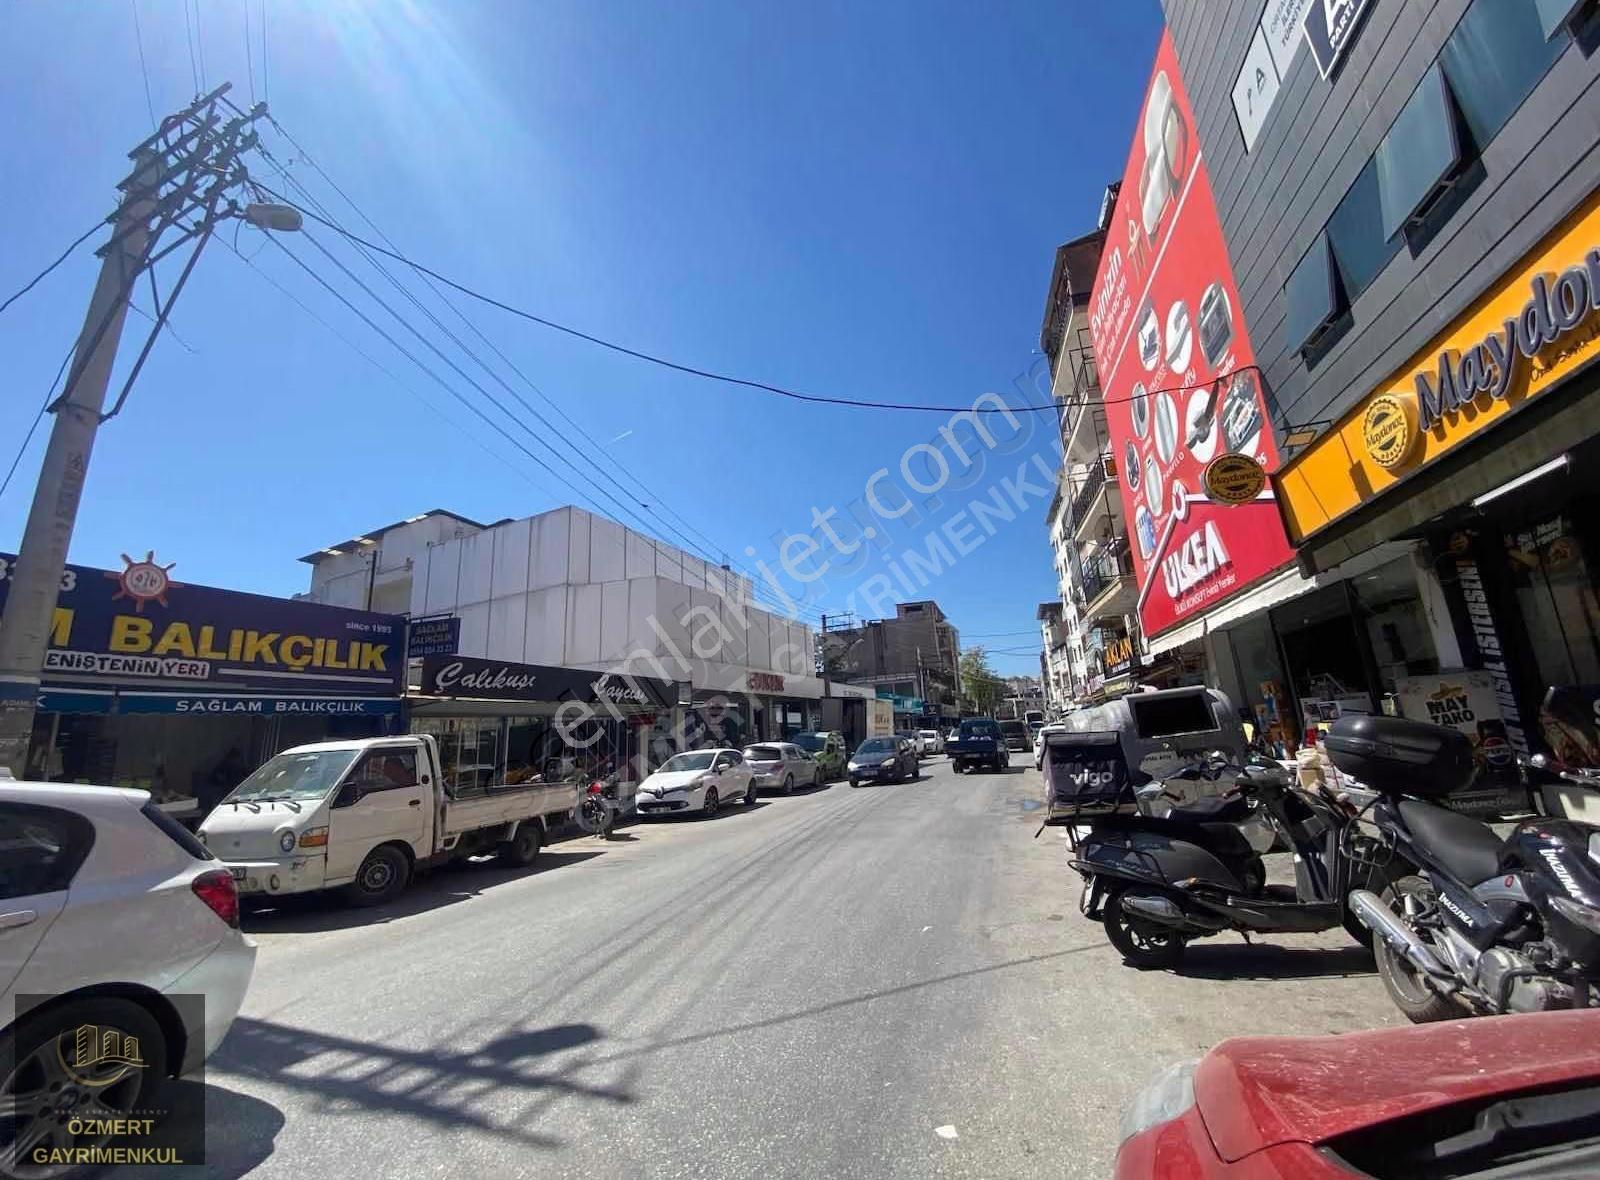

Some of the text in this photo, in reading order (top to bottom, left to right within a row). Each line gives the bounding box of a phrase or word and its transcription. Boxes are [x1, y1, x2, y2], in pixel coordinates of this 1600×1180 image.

[109, 616, 389, 671] BALIKÇILIK
[175, 700, 365, 713] SAĞLAM BALIKÇILIK
[1425, 695, 1469, 714] MAY
[1069, 768, 1113, 787] vigo
